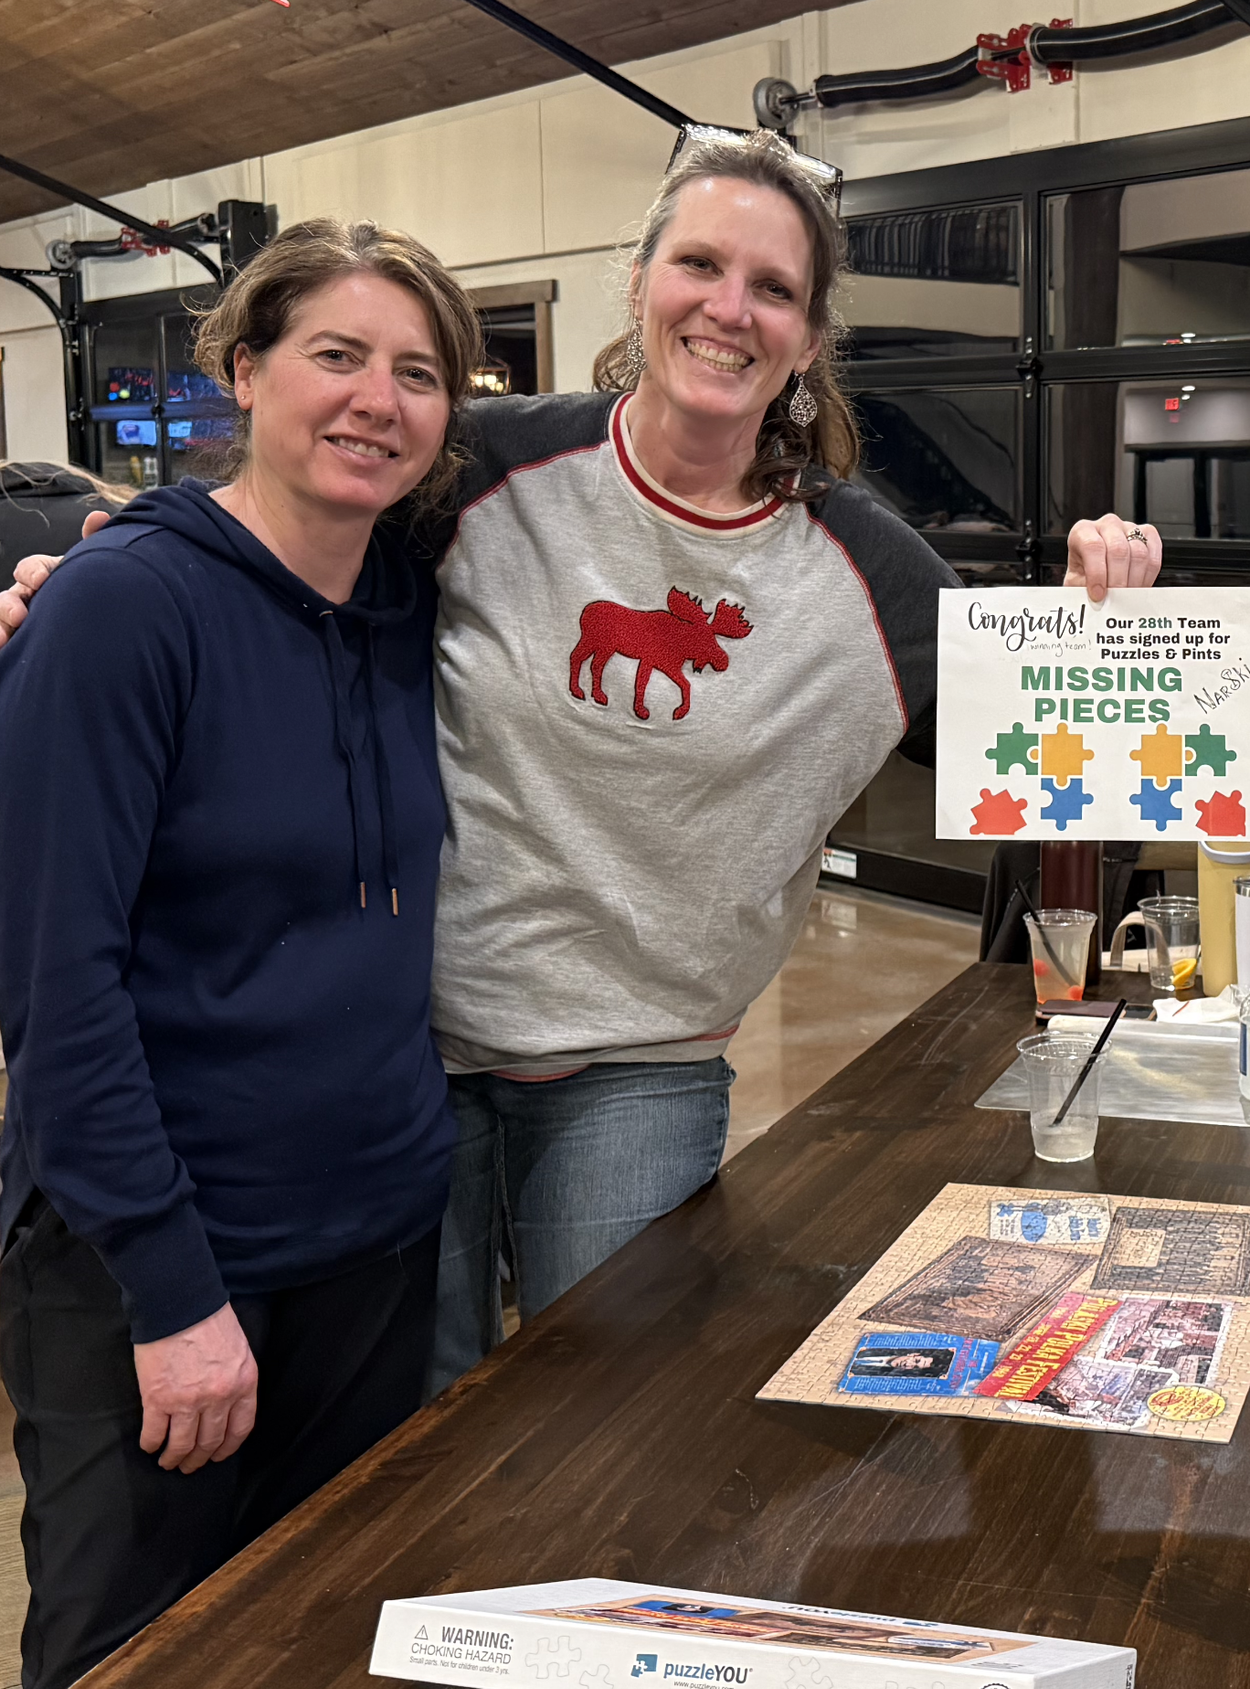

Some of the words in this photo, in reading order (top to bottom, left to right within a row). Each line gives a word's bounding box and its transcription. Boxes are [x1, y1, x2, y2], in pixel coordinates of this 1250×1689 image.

[967, 601, 1086, 652] Congrats!
[1105, 617, 1134, 629] Our
[1138, 617, 1173, 629] 28th
[1177, 617, 1221, 629] Team
[1096, 632, 1125, 644] has
[1129, 632, 1180, 647] signed
[1185, 635, 1204, 647] up
[1208, 632, 1231, 644] for
[1101, 648, 1160, 660] Puzzles
[1165, 648, 1178, 660] &
[1182, 648, 1222, 660] Pints
[1021, 665, 1183, 692] MISSING
[1034, 698, 1171, 724] PIECES
[1032, 1331, 1088, 1361] POLKA
[993, 1360, 1061, 1398] FESTIVAL
[441, 1626, 515, 1650] WARNING:
[409, 1656, 425, 1665] Small
[424, 1659, 438, 1667] parts.
[440, 1660, 450, 1668] Not
[450, 1661, 458, 1669] for
[458, 1662, 479, 1671] children
[479, 1665, 495, 1673] under
[411, 1642, 463, 1659] CHOKING
[465, 1650, 512, 1665] HAZARD
[663, 1662, 748, 1684] puzzleYOU
